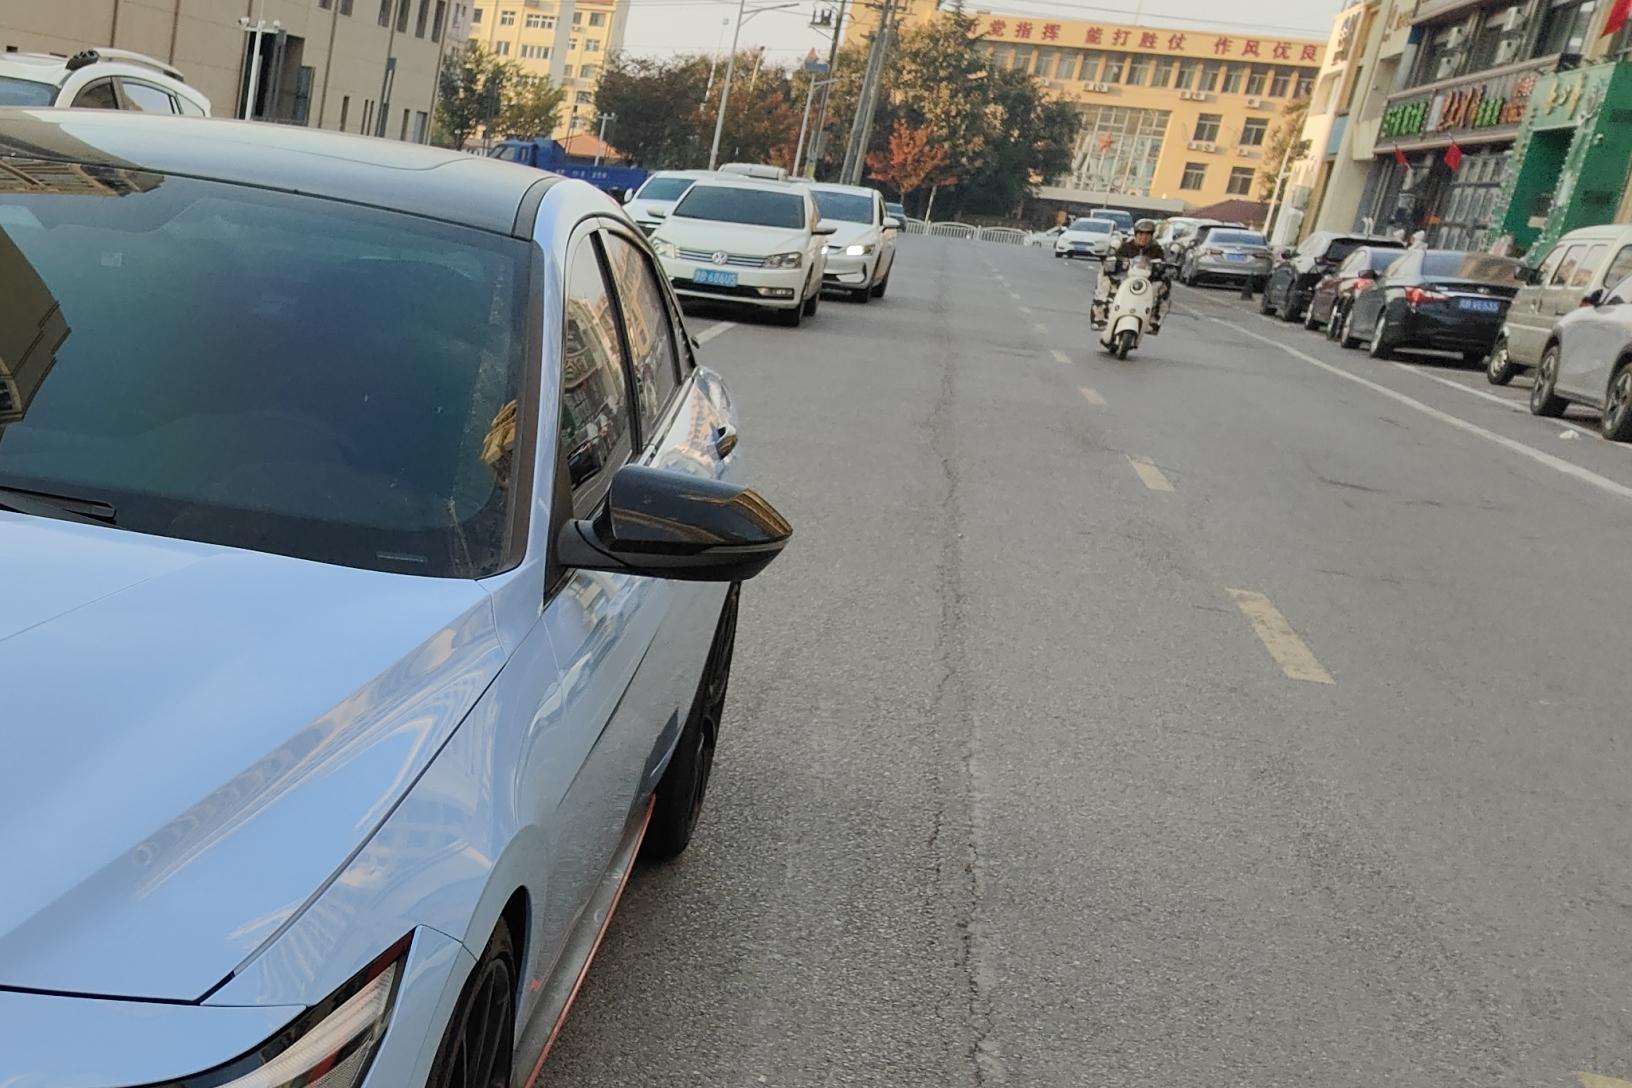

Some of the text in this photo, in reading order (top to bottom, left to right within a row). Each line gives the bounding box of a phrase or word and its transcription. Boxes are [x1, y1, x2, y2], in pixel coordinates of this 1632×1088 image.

[1085, 26, 1186, 50] 能打胜仗
[1214, 37, 1318, 62] 作风优良
